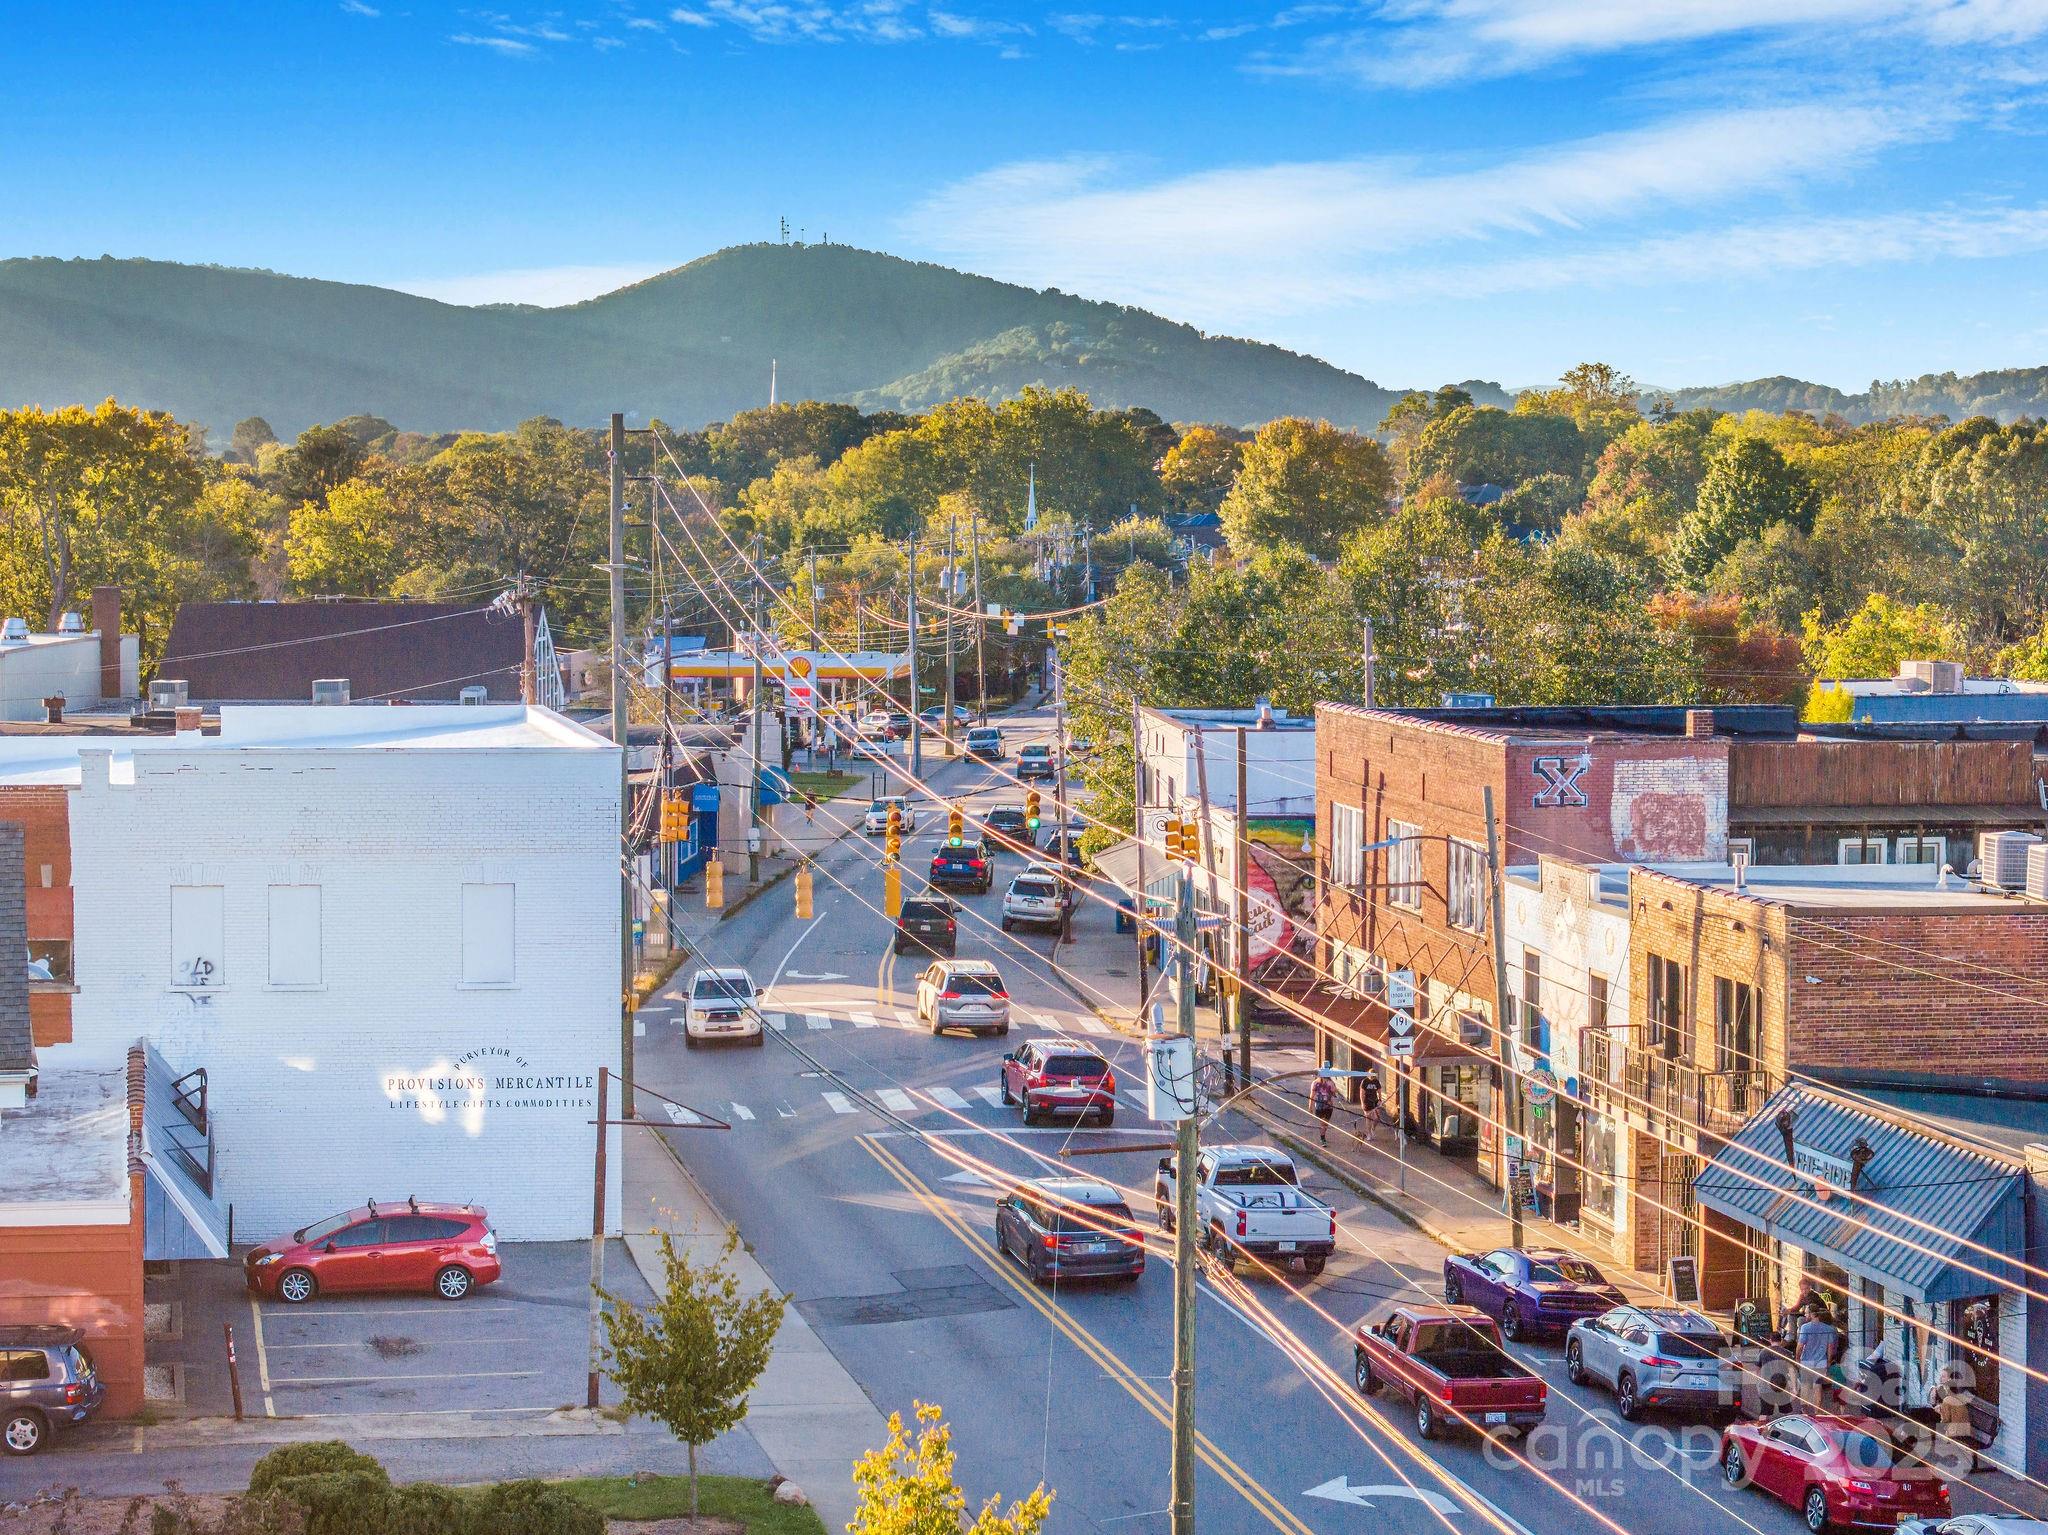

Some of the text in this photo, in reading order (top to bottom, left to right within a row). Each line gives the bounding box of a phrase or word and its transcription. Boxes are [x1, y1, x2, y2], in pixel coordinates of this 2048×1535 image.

[1395, 1016, 1408, 1027] 191
[453, 1046, 529, 1071] PURVEYOR OF
[388, 1076, 594, 1091] PROVISIONS MERCANTILE
[506, 1099, 593, 1108] COMMODITIES
